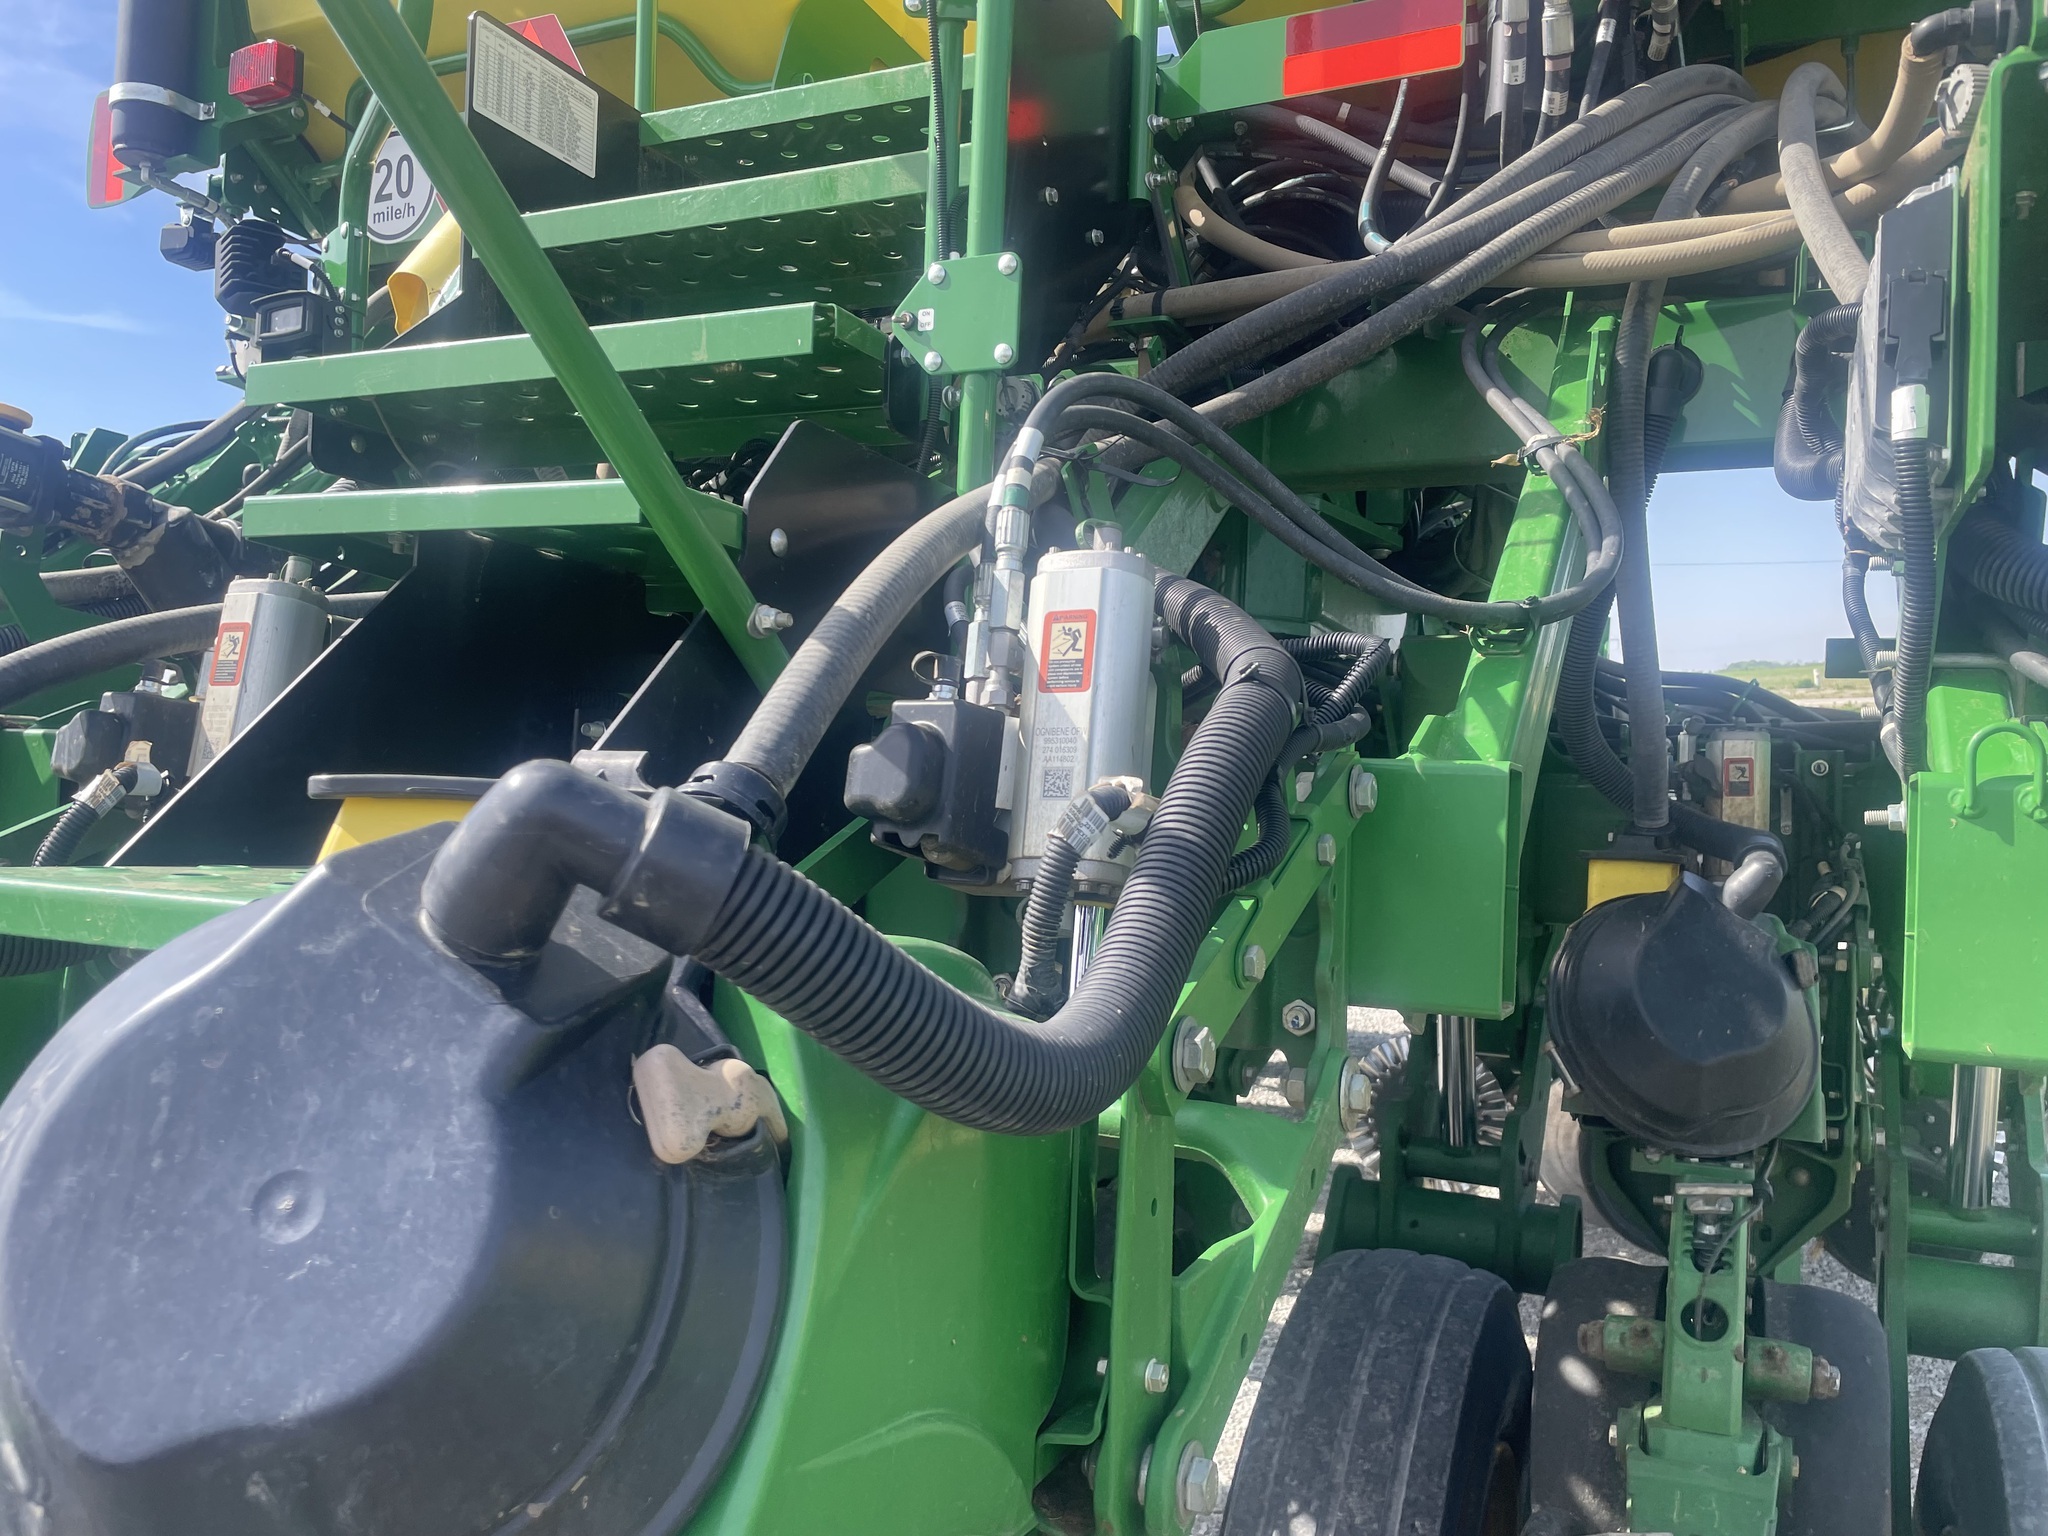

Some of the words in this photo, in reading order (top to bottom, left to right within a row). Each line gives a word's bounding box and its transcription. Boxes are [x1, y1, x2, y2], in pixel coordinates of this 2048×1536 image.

[374, 153, 414, 204] 20
[373, 202, 415, 224] mile/h
[919, 321, 931, 329] OFF
[1035, 727, 1070, 737] OGNIBENE
